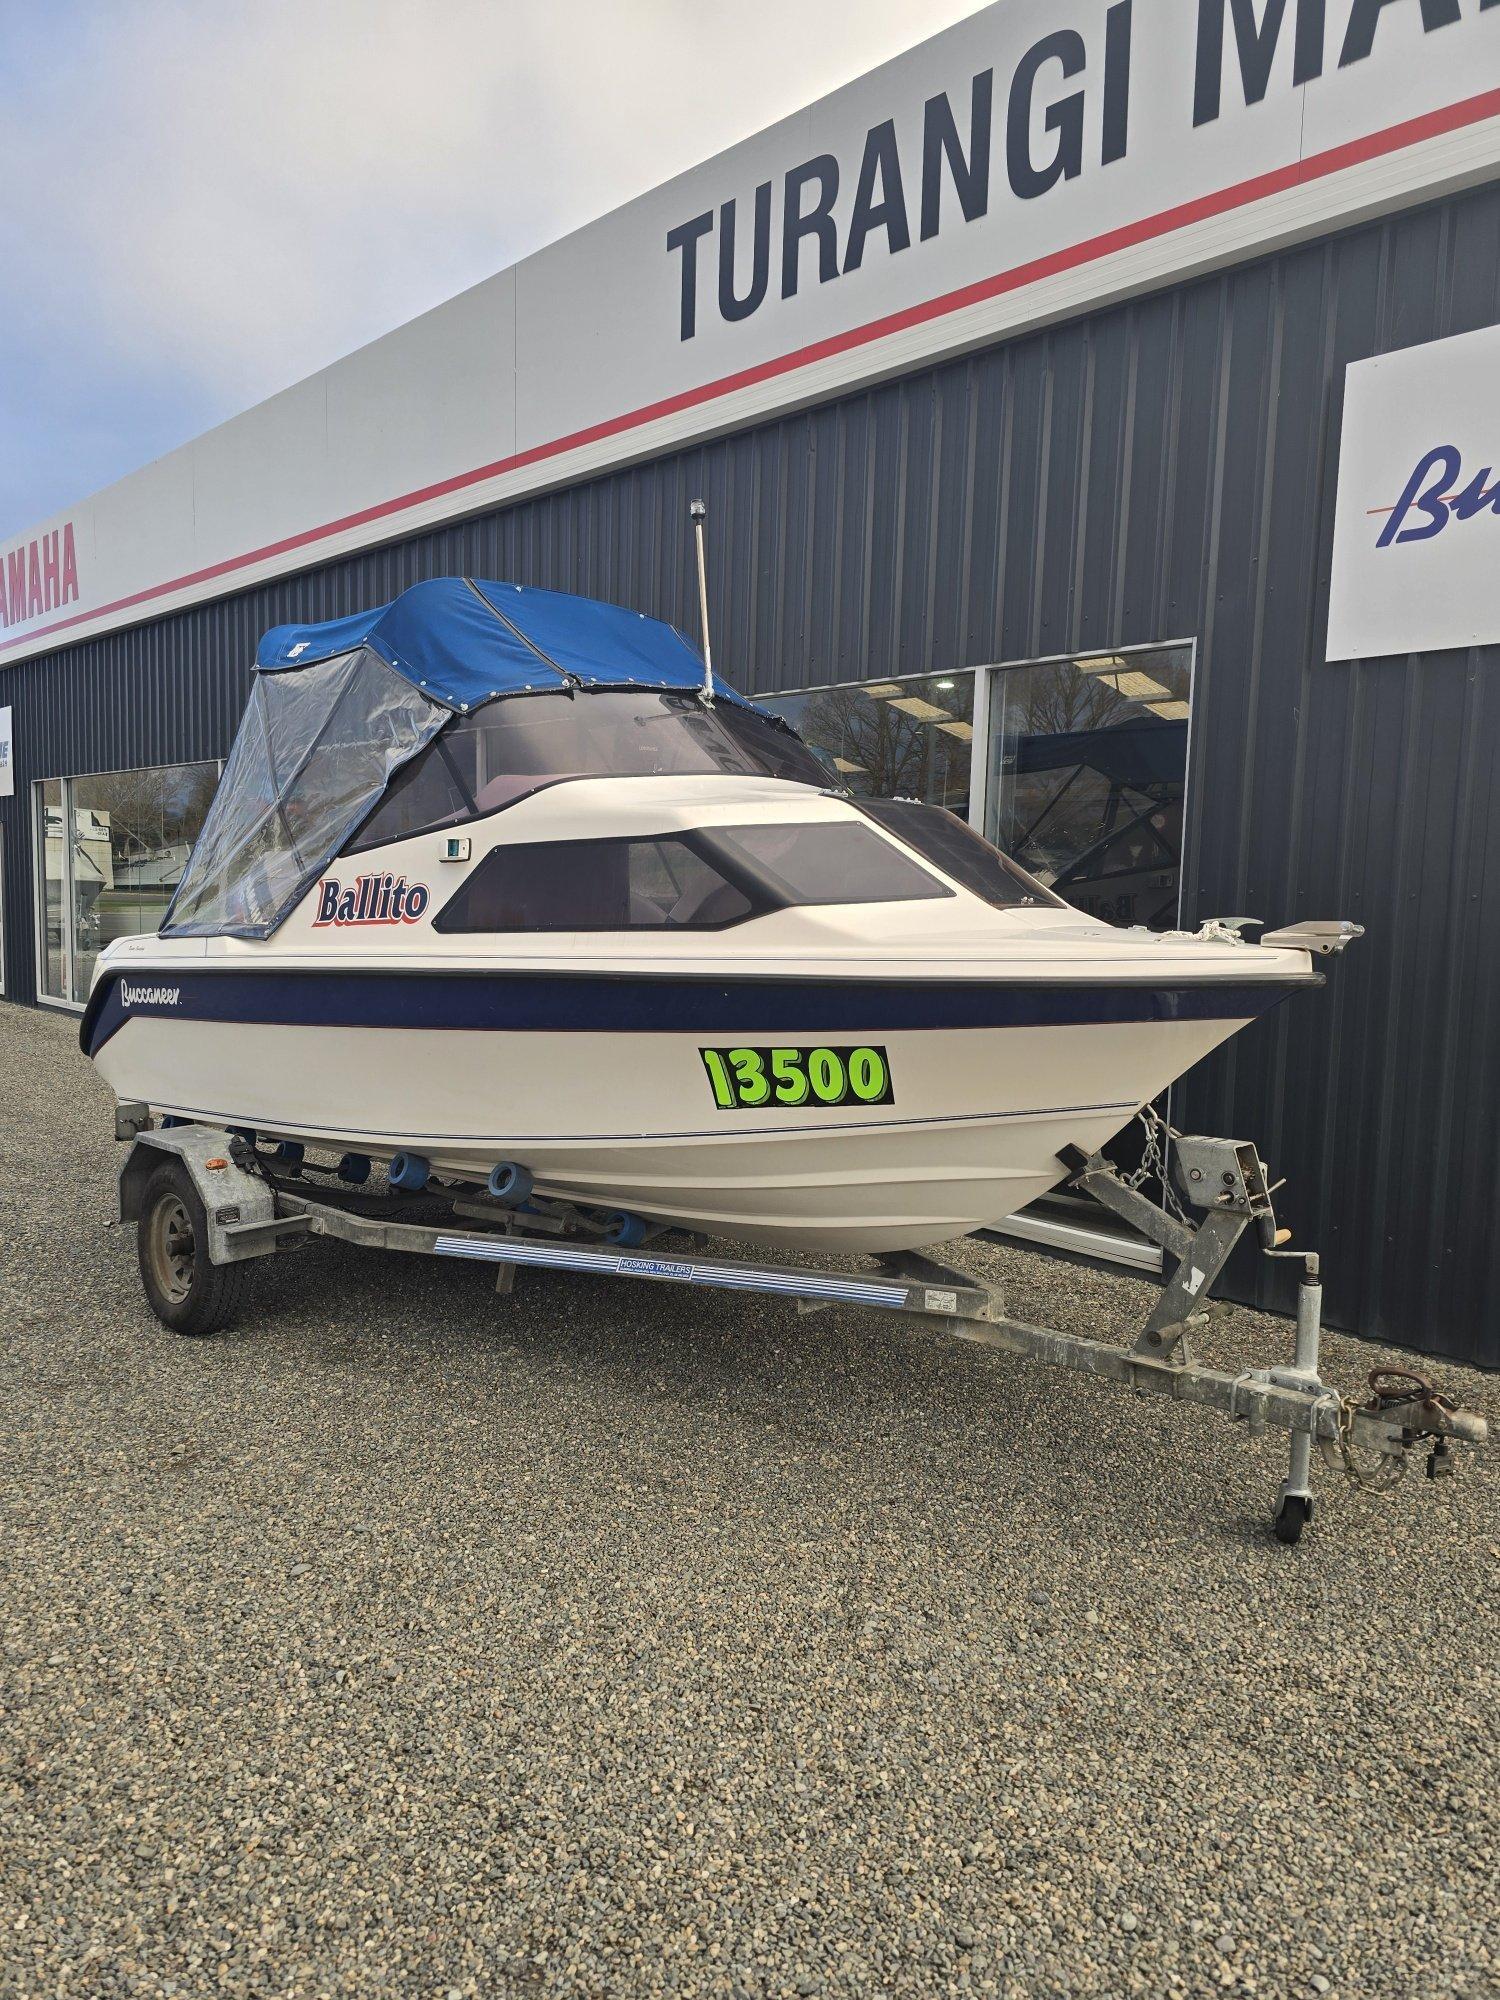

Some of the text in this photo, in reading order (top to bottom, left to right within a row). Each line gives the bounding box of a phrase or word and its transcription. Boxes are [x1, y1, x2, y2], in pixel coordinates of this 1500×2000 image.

[667, 0, 1131, 342] TURANGI
[313, 872, 430, 927] Ballito
[704, 1048, 889, 1108] 13500
[620, 1259, 655, 1270] HOSKING
[655, 1263, 691, 1274] TRAILERS
